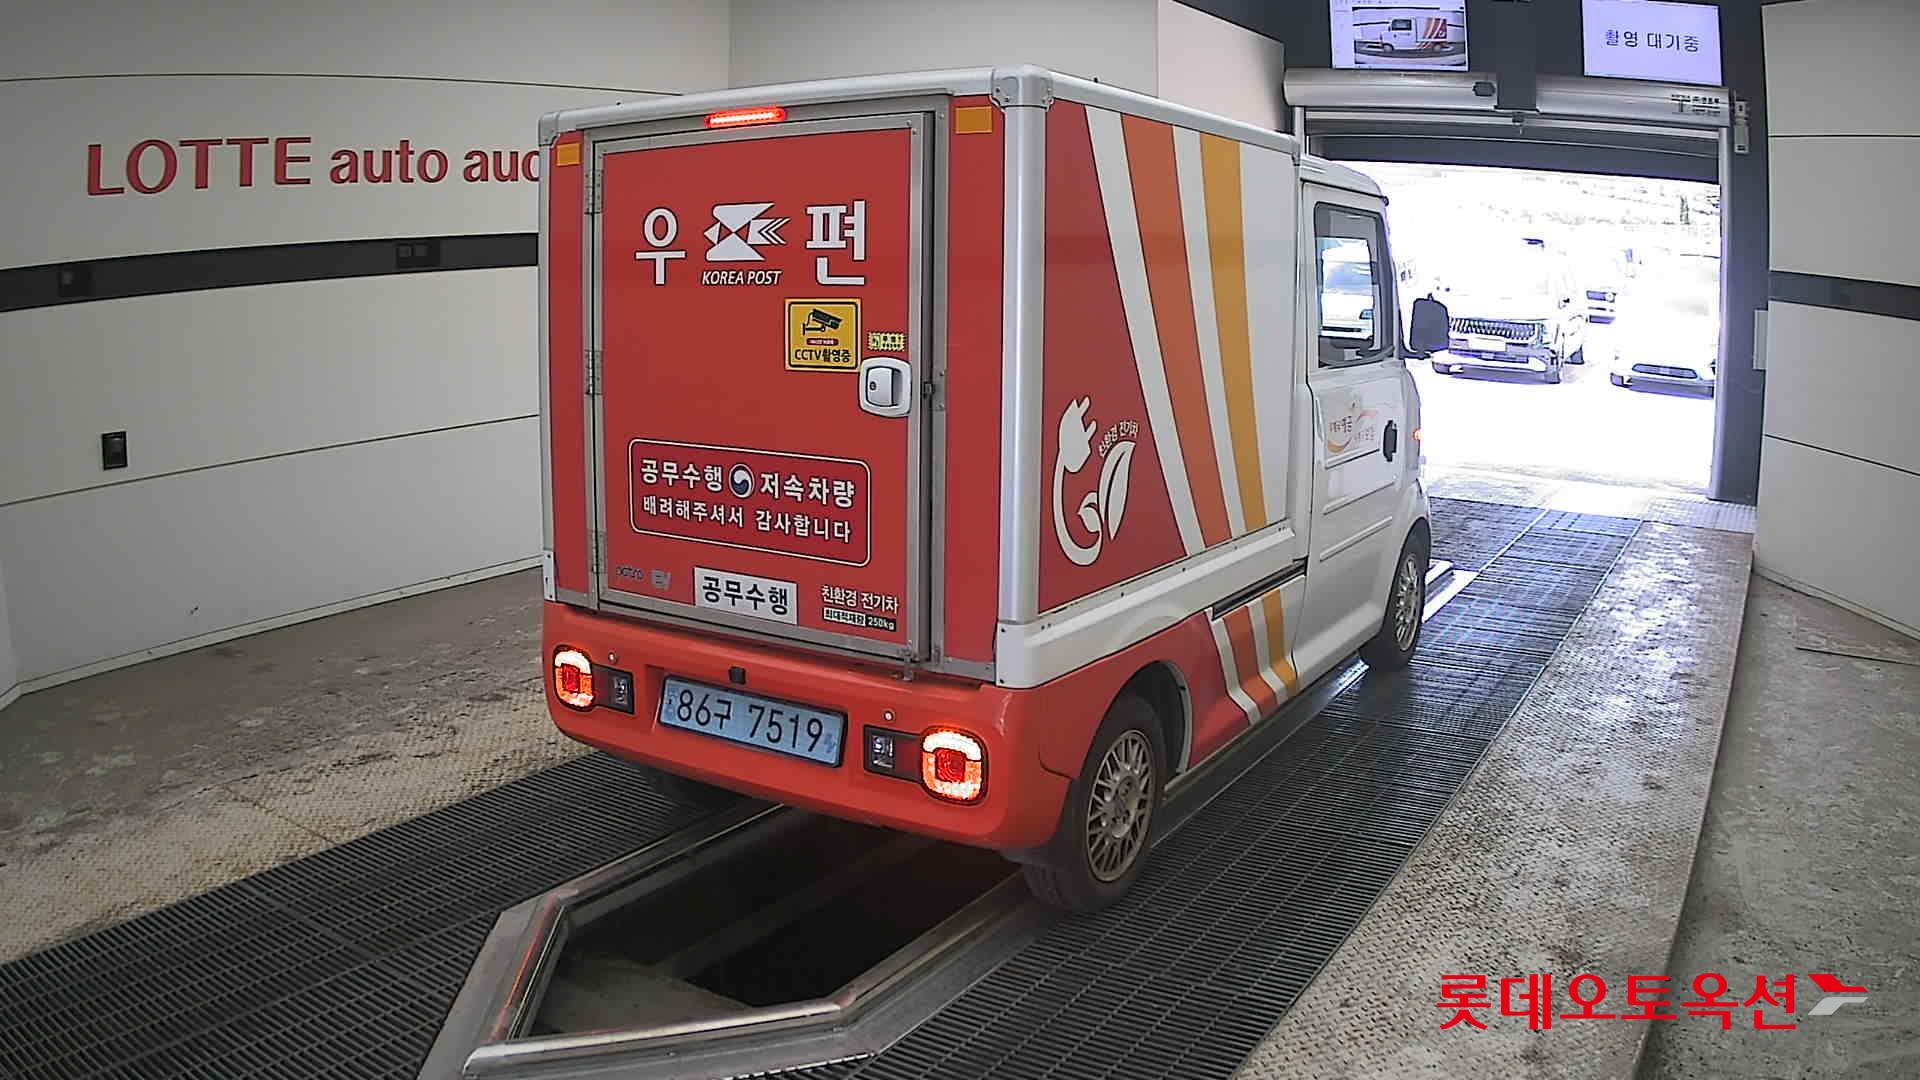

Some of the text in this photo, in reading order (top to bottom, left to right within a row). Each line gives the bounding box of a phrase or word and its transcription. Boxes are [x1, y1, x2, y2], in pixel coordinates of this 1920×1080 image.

[1647, 32, 1699, 52] 대기중
[87, 136, 312, 196] LOTTE
[329, 138, 449, 184] auto
[701, 270, 783, 286] KOREA POST
[641, 458, 856, 508] 공무수행 저속차량
[642, 495, 851, 543] 배려해주셔서 감사합니다
[702, 575, 789, 615] 공무수행
[821, 585, 899, 615] 친환경 전기차
[868, 616, 895, 631] 250kg
[677, 689, 732, 730] 86구
[748, 704, 824, 753] 7519
